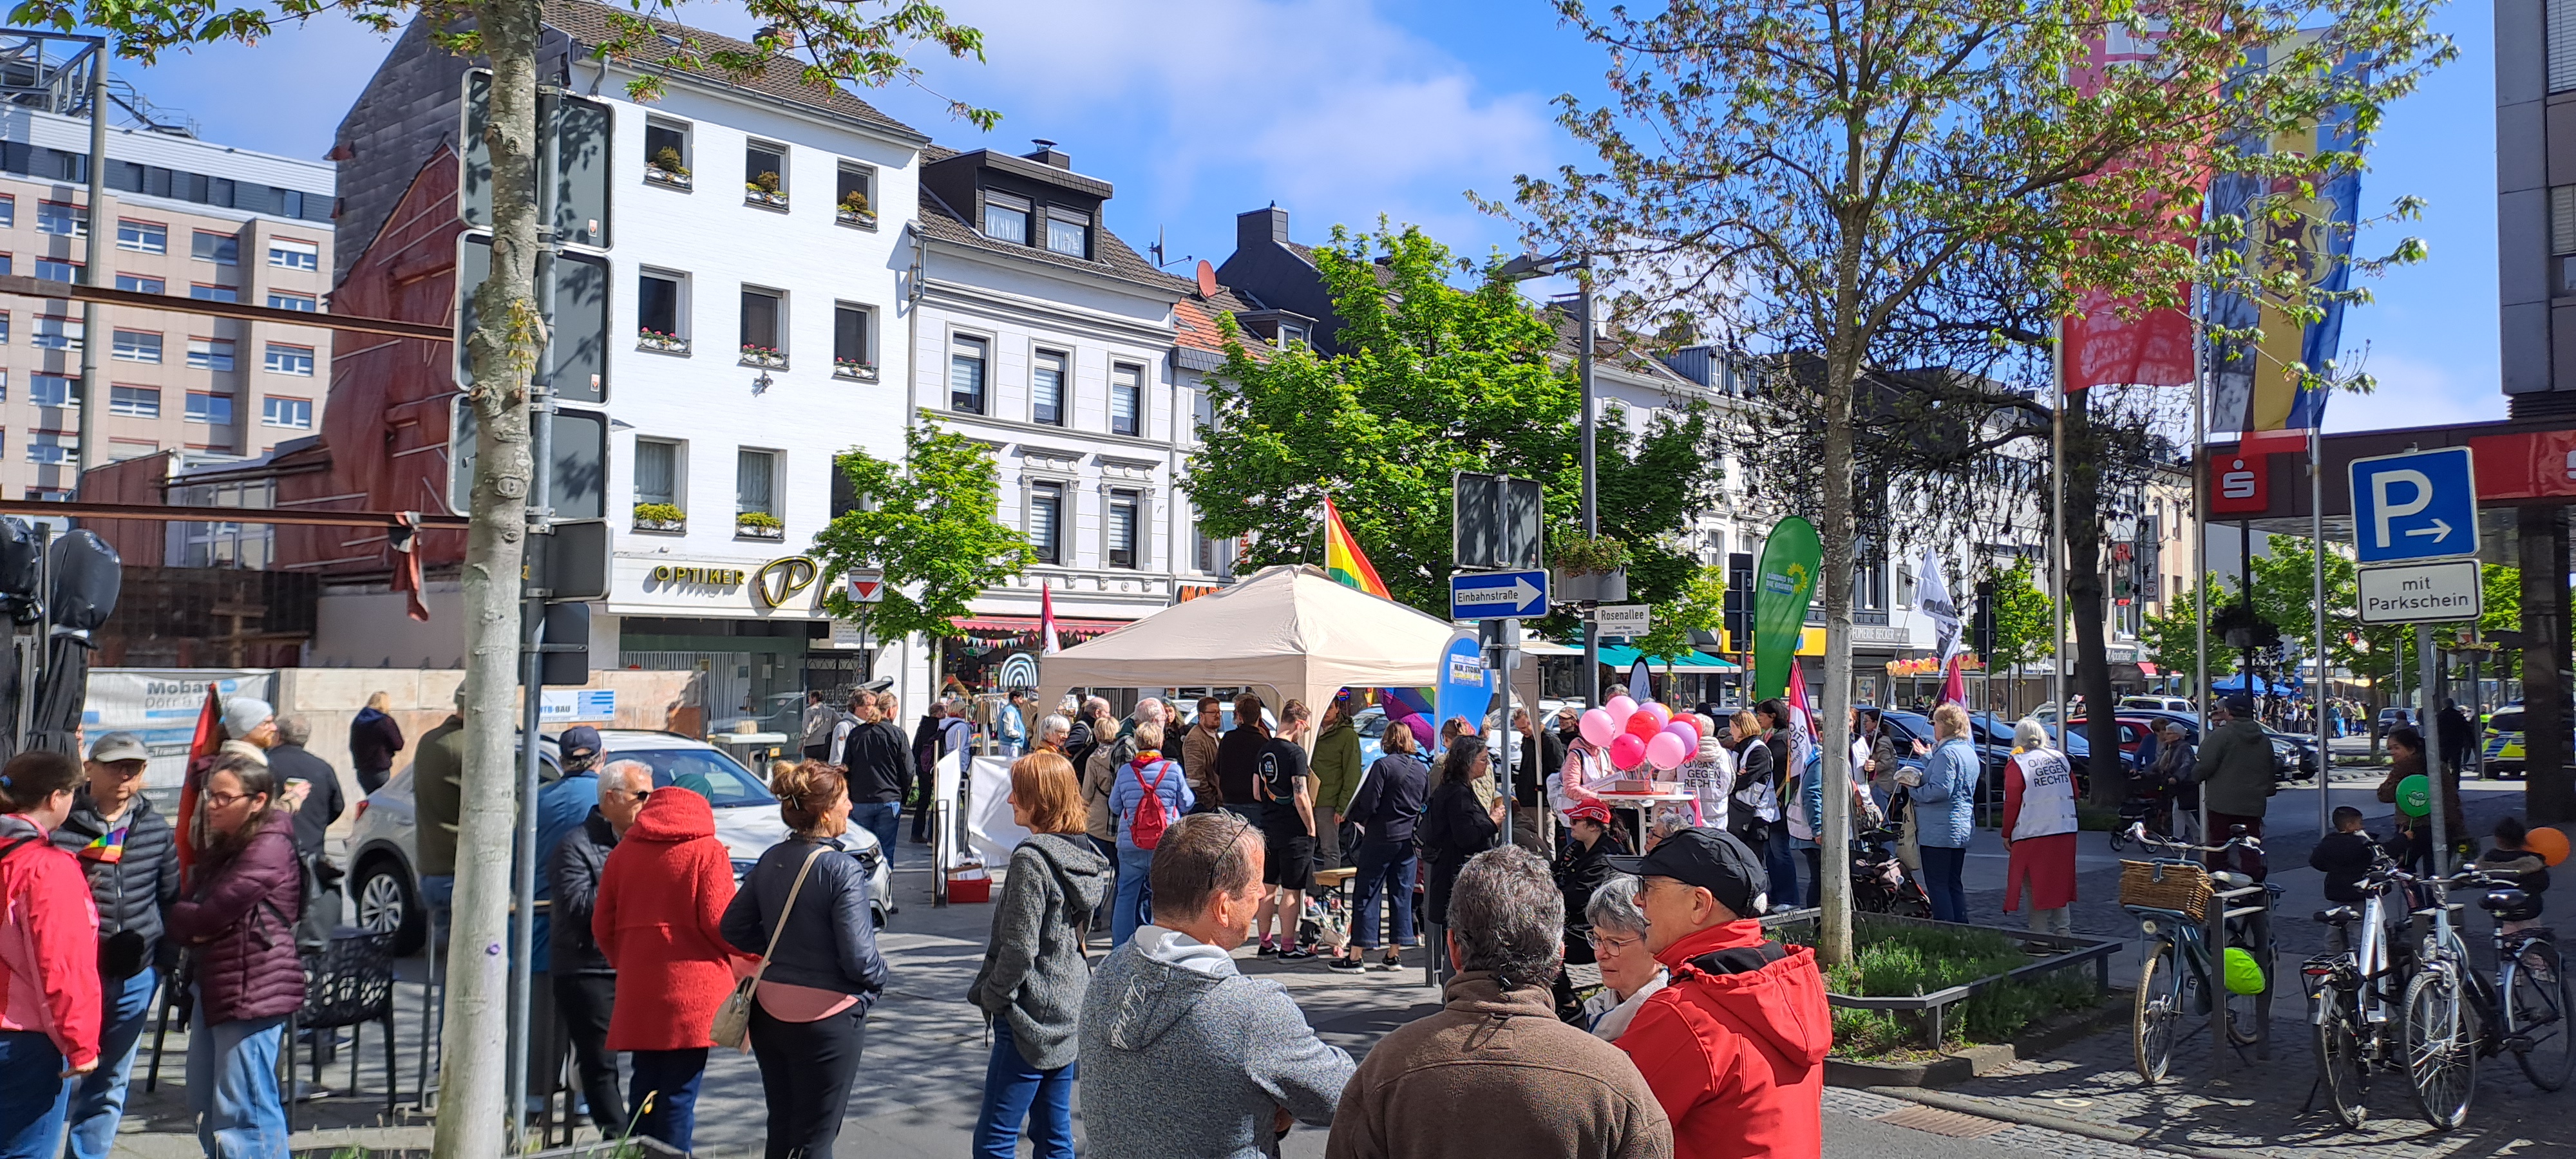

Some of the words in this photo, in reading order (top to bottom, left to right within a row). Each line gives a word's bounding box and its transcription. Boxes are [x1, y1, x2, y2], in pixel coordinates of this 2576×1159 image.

[655, 565, 745, 585] OPTIKER
[2402, 576, 2432, 591] mit
[1457, 590, 1519, 603] Einbahnstraße
[2368, 593, 2468, 611] Parkschein
[1601, 609, 1644, 621] Rosenallee
[1875, 628, 1895, 640] BECKER
[1687, 769, 1721, 779] GEGEN
[2034, 774, 2069, 787] RECHTS
[1685, 779, 1721, 789] RECHTS
